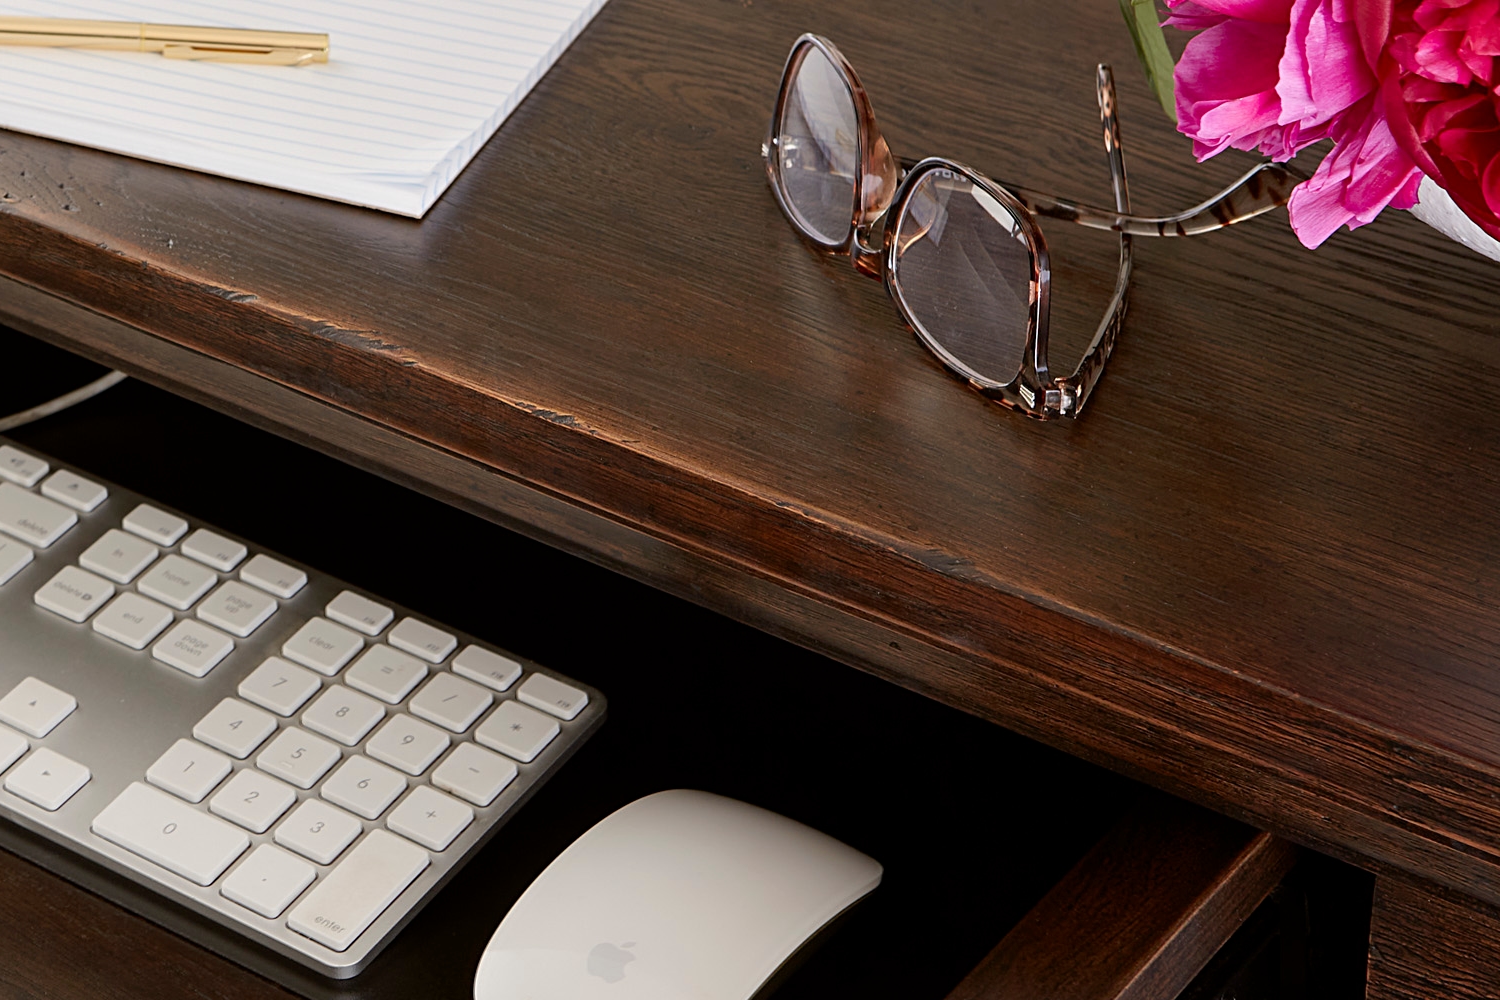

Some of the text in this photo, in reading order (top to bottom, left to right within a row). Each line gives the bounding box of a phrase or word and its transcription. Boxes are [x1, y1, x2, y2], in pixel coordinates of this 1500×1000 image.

[16, 518, 49, 537] delete
[161, 569, 191, 587] home
[52, 580, 81, 597] delete
[225, 595, 253, 611] page
[224, 605, 241, 615] up
[121, 612, 145, 625] end
[182, 634, 210, 649] page
[308, 636, 336, 651] clear
[173, 642, 203, 657] down
[272, 676, 289, 688] 7
[334, 706, 351, 718] 8
[228, 719, 244, 731] 4
[401, 734, 416, 746] 9
[290, 747, 307, 760] 5
[182, 760, 196, 773] 1
[356, 778, 371, 790] 6
[243, 791, 260, 804] 2
[162, 822, 178, 835] 0
[309, 821, 326, 834] 3
[314, 914, 346, 935] enter
